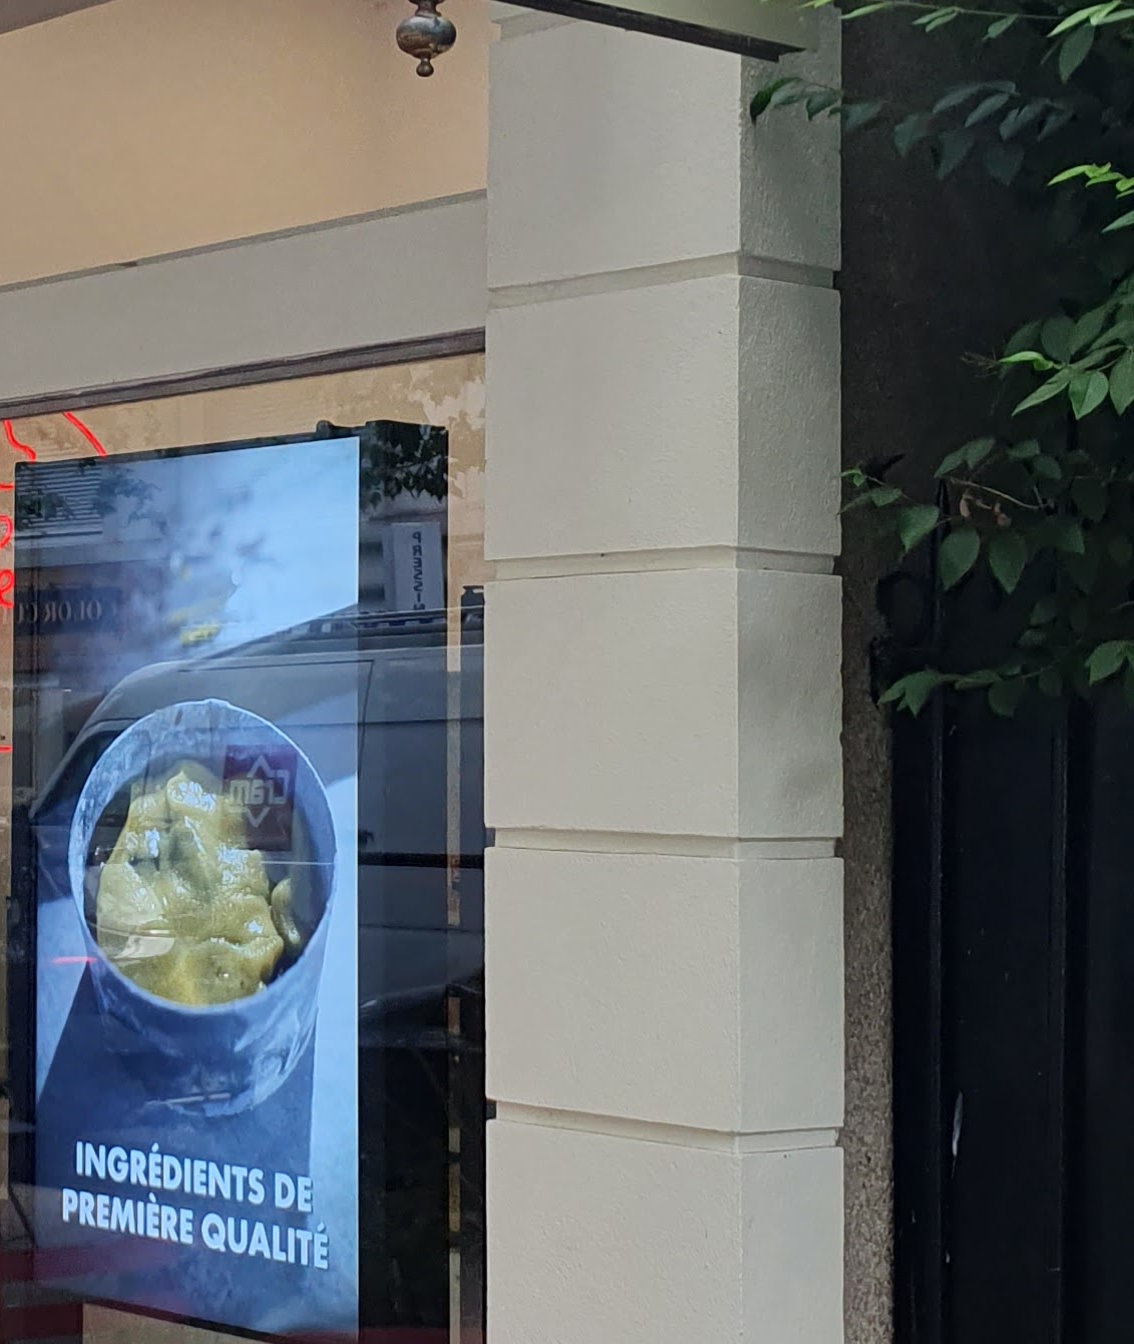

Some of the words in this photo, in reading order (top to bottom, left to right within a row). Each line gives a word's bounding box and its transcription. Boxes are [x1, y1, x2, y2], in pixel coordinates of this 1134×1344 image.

[75, 1140, 266, 1206] INGRÉDIENTS
[274, 1173, 314, 1214] DE
[62, 1187, 194, 1245] PREMIÈRE
[200, 1212, 329, 1270] QUALITÉ
